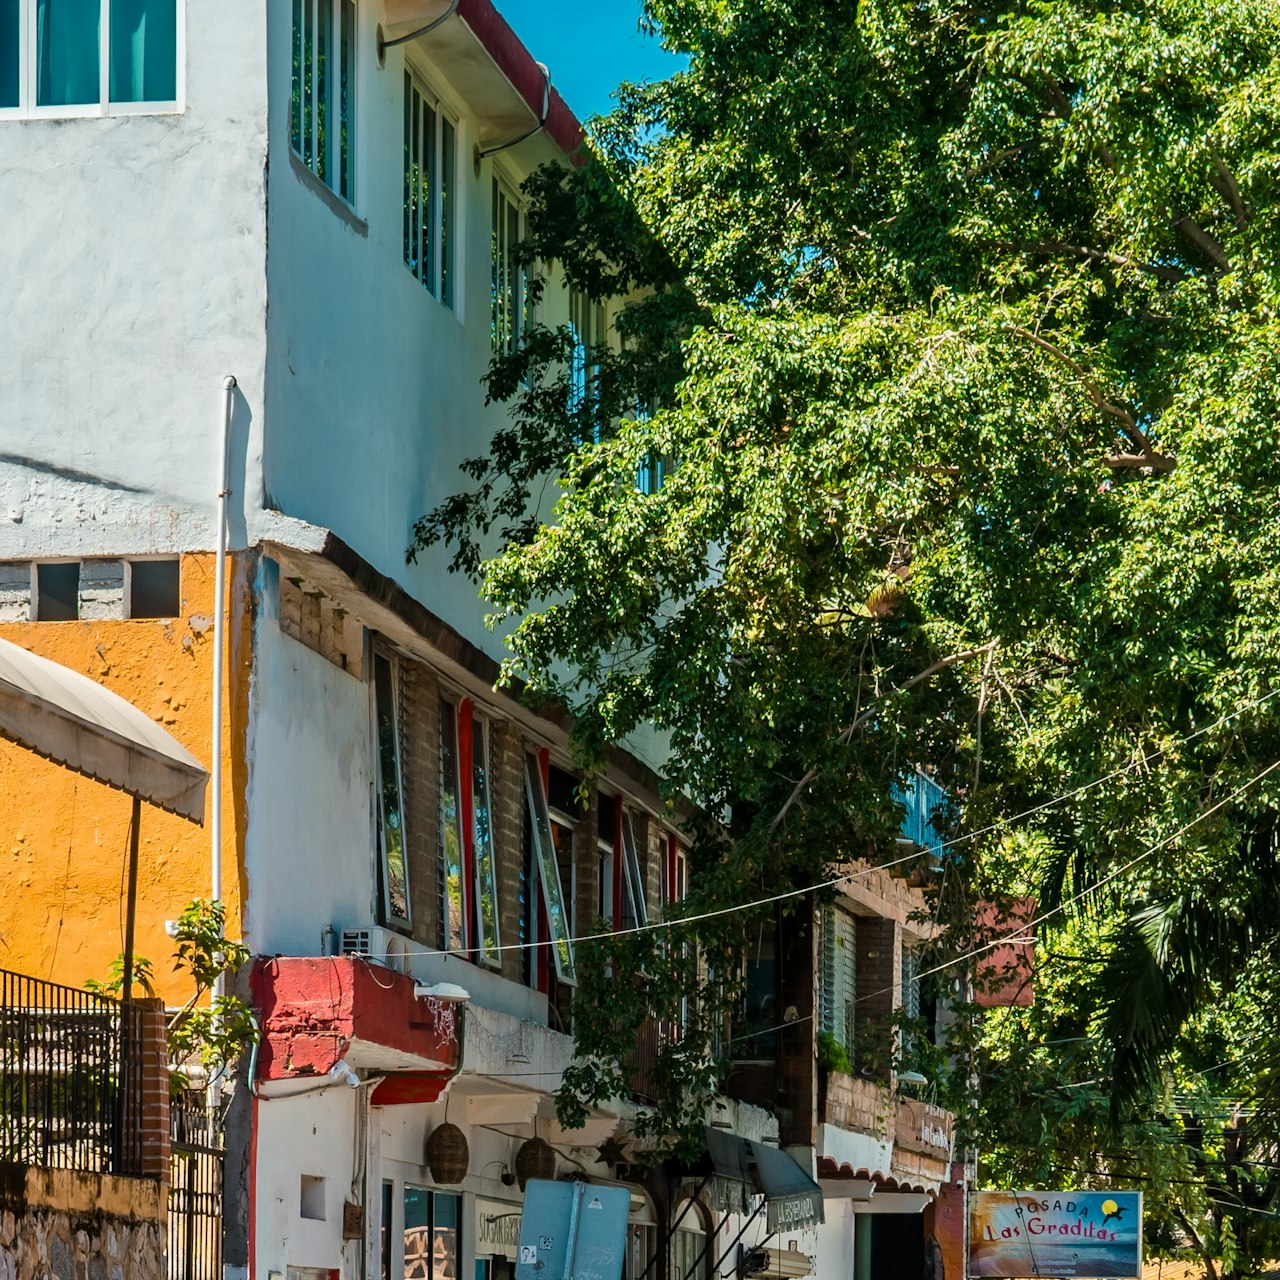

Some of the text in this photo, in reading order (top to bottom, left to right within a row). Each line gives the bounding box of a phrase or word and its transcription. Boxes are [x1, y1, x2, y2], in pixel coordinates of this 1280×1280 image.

[1014, 1199, 1089, 1219] POSADA
[986, 1217, 1118, 1242] Las Graditas
